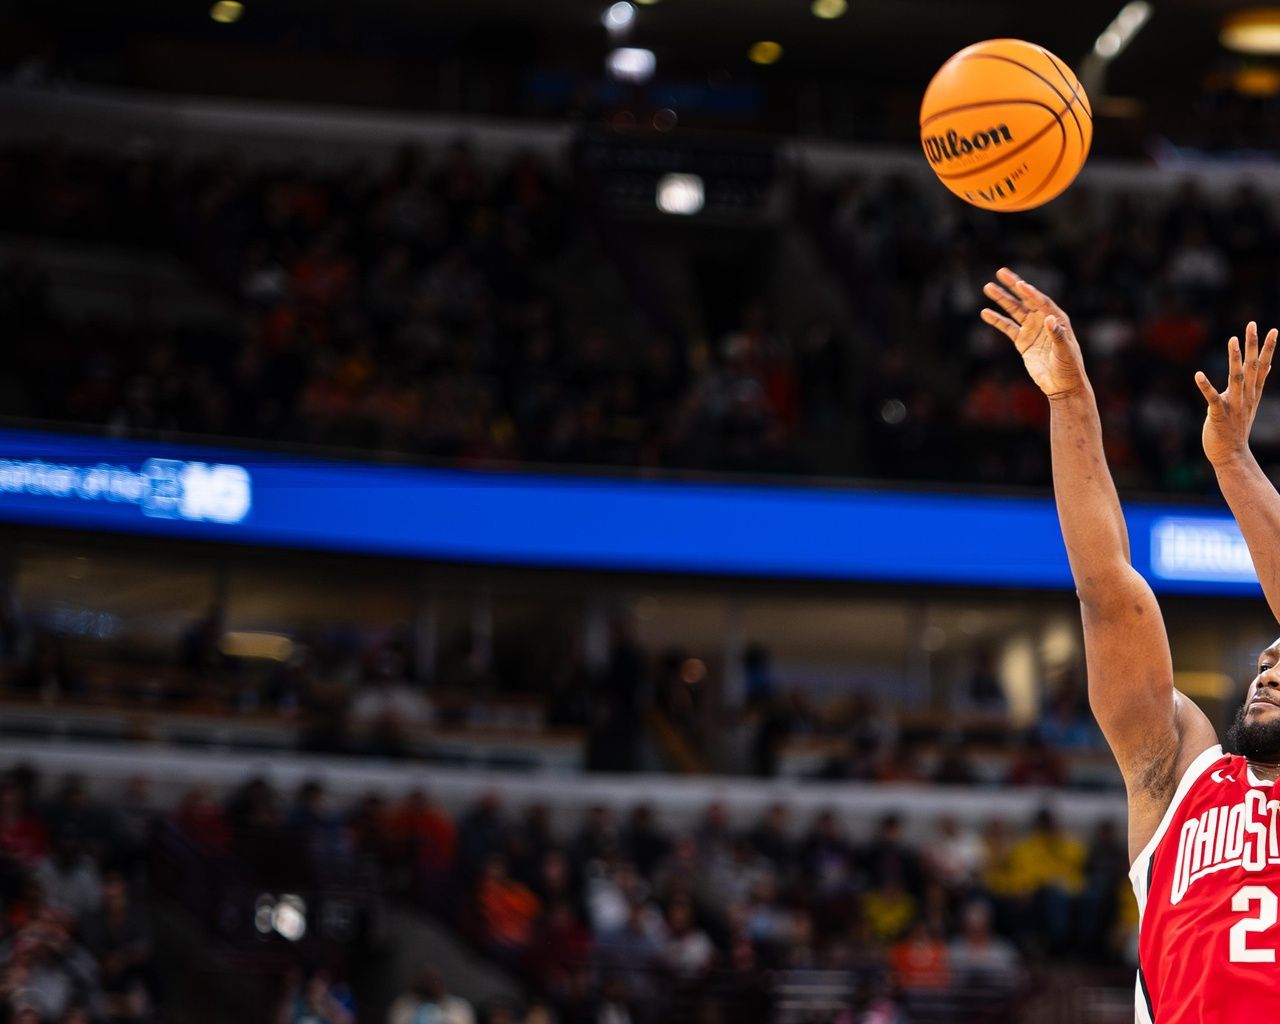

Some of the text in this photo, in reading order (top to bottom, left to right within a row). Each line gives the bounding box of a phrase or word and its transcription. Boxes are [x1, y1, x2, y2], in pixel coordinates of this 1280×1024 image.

[924, 123, 1014, 165] Wilson
[1170, 799, 1246, 906] OHIO
[1229, 885, 1278, 963] 2
